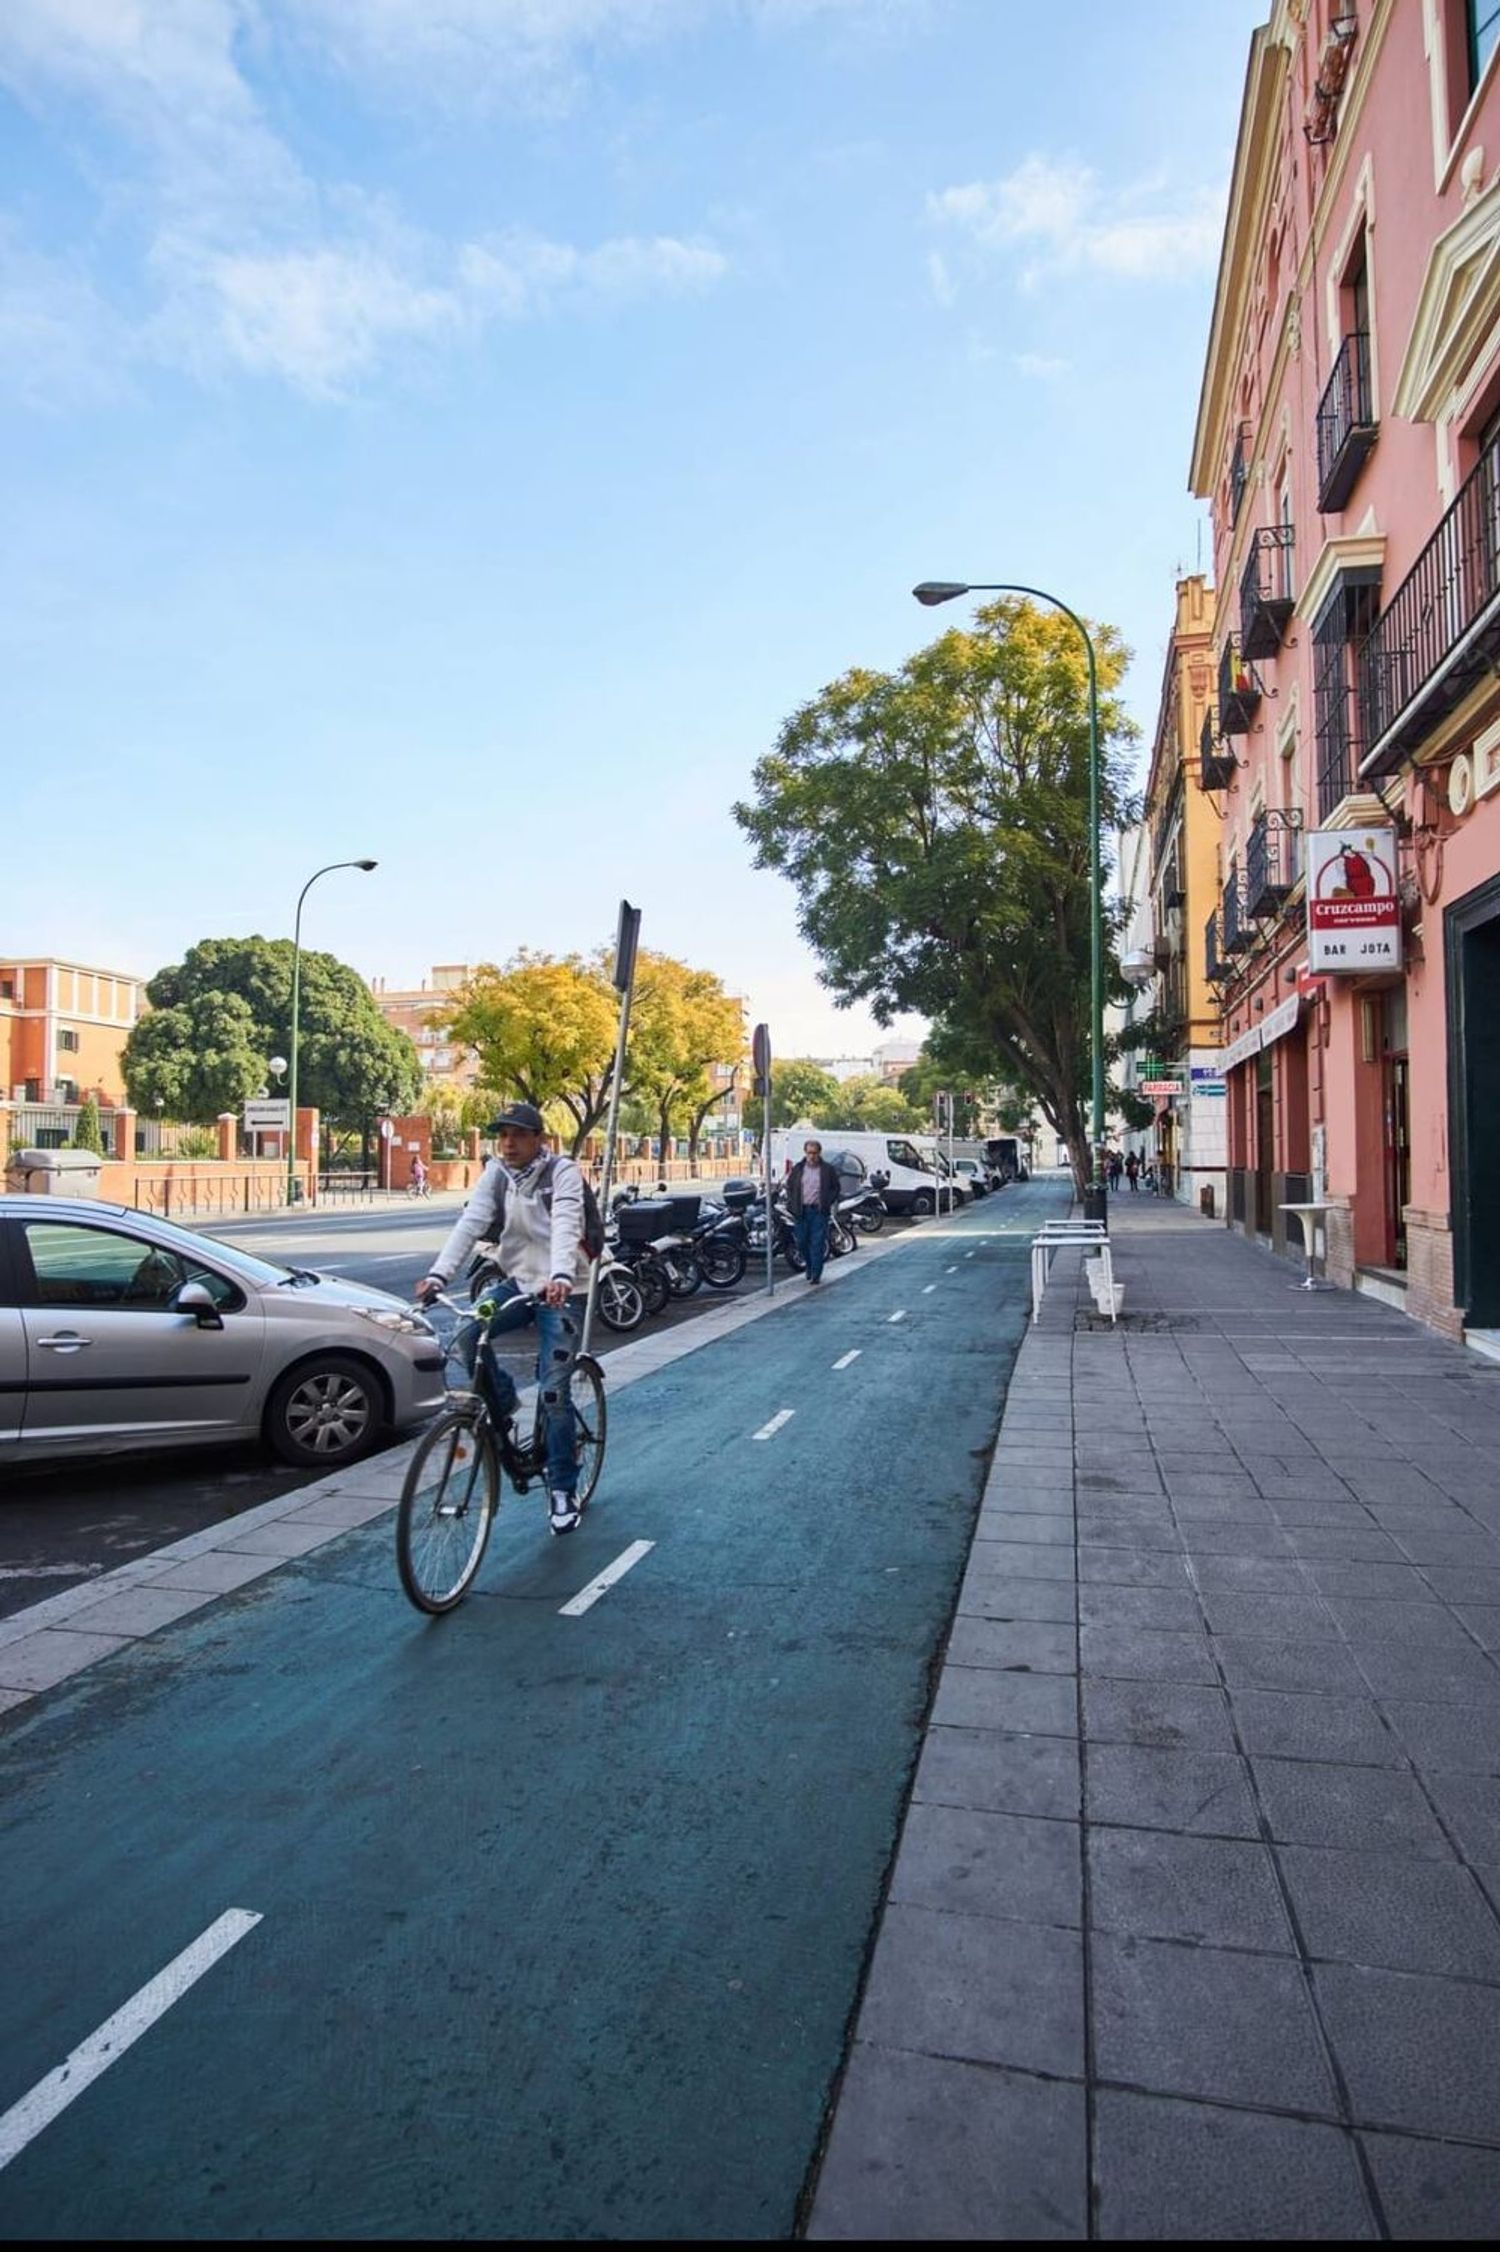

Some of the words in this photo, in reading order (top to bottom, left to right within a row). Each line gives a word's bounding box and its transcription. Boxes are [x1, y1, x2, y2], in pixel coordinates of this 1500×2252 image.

[1316, 901, 1394, 916] Cruzcampo
[1323, 944, 1346, 956] BAR
[1360, 942, 1391, 955] JOTA
